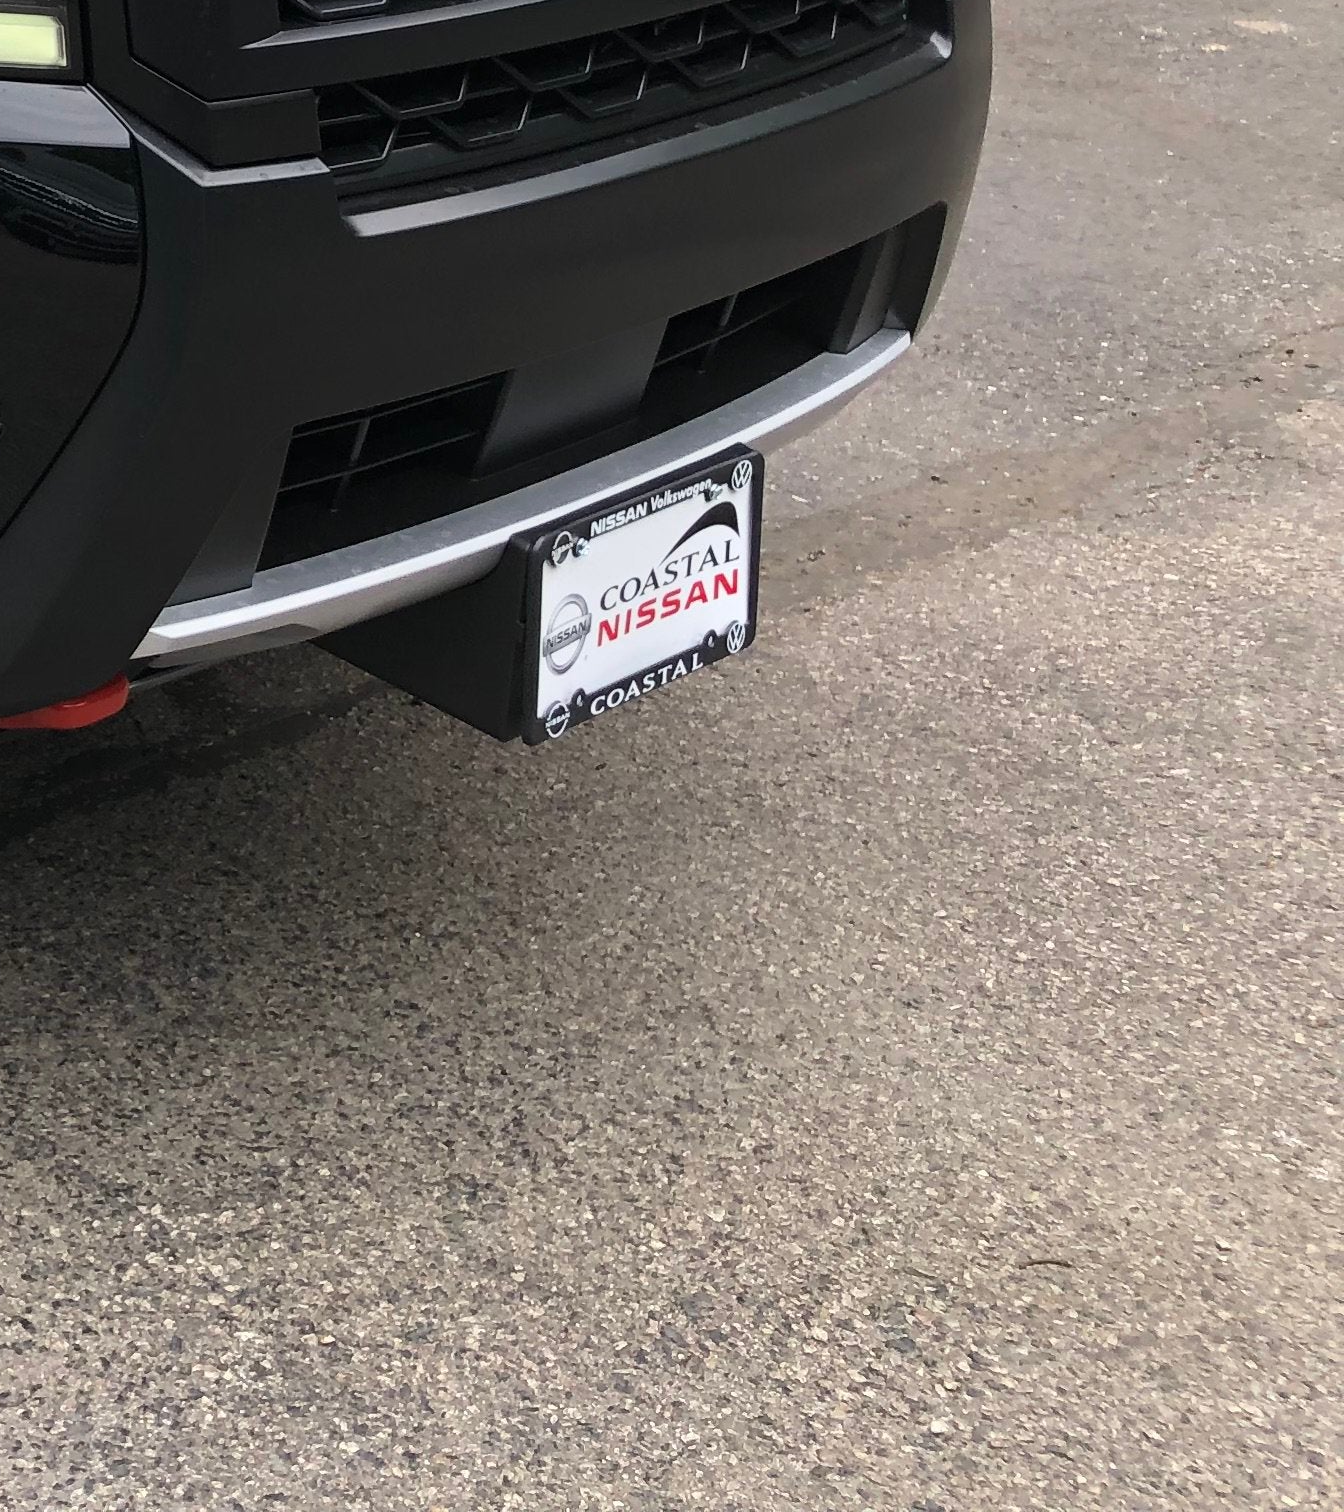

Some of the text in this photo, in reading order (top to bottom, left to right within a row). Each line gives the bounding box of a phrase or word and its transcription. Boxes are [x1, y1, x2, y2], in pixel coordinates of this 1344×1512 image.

[590, 478, 713, 537] NISSAN Volkswagen
[599, 539, 740, 612] COASTAL
[546, 619, 590, 649] NISSAN
[596, 568, 739, 647] NISSAN
[590, 653, 705, 716] COASTAL
